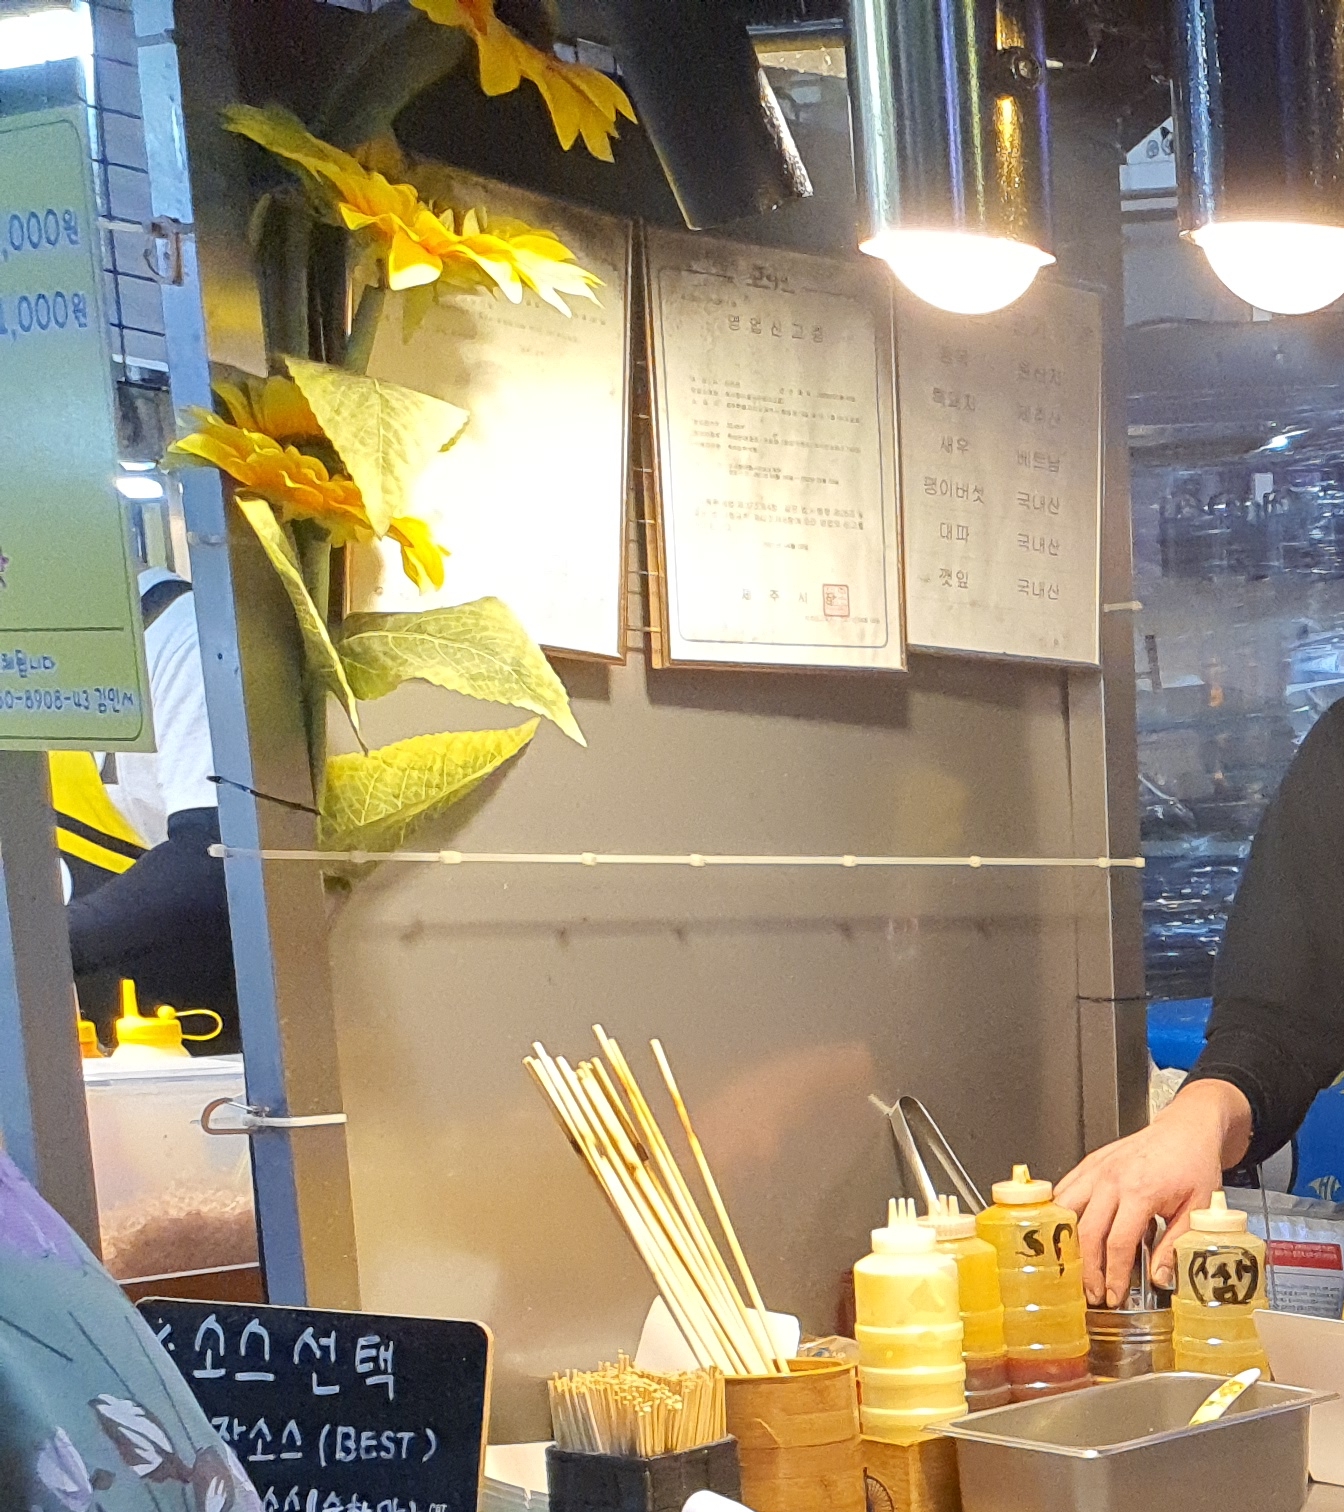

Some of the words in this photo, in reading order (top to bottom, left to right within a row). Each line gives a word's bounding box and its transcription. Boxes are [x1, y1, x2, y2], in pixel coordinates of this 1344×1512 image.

[1017, 491, 1060, 515] 국내산
[940, 522, 970, 544] 대파
[1017, 533, 1060, 556] 국내산
[1017, 579, 1060, 601] 국내산
[193, 1313, 276, 1381] 소스
[293, 1326, 395, 1401] 선택
